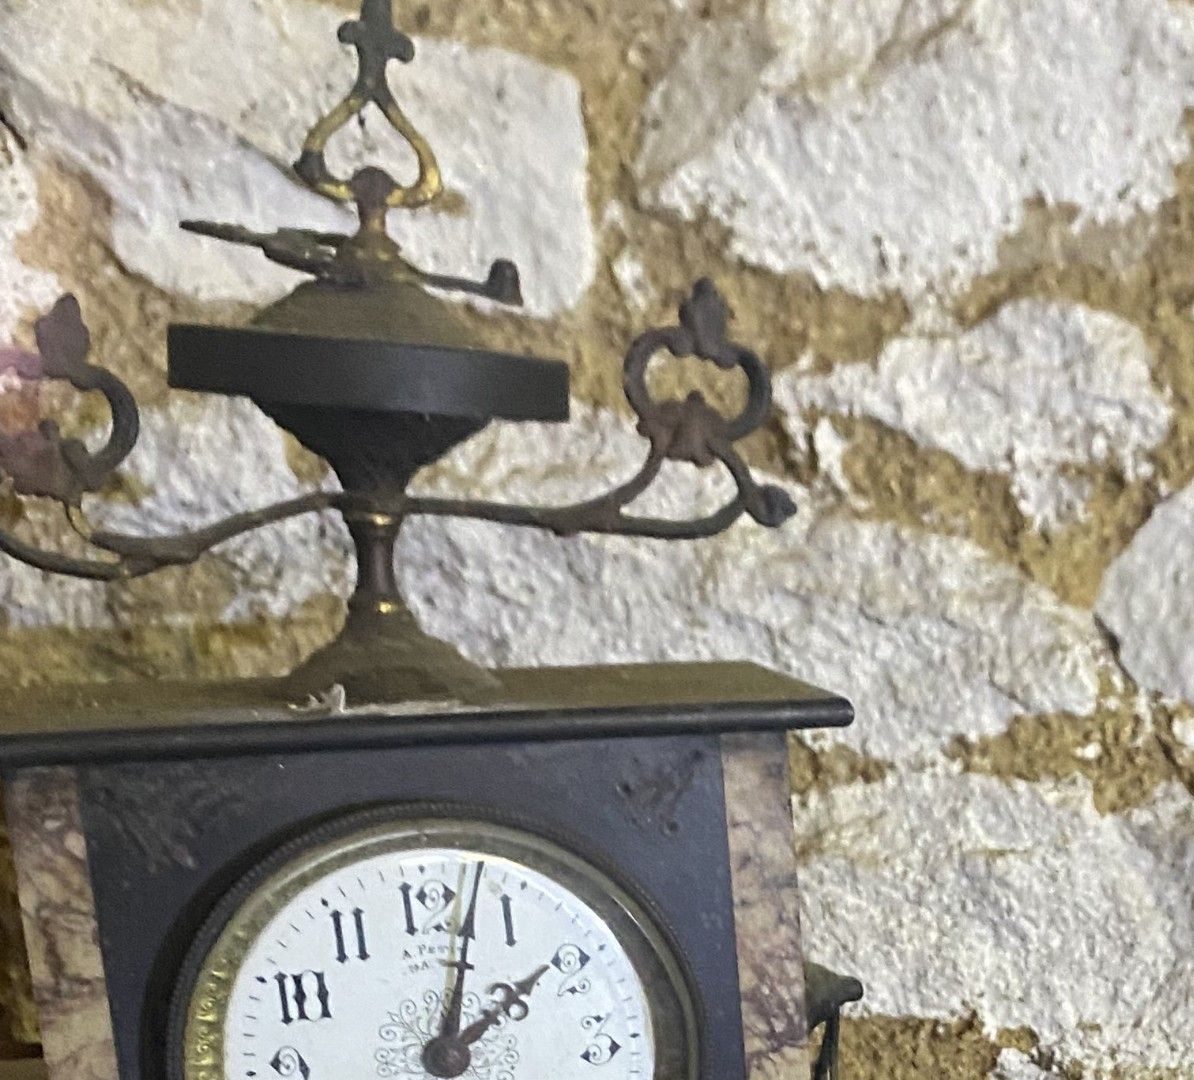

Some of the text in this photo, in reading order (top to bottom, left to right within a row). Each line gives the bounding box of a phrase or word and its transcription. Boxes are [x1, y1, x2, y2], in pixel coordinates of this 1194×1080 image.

[331, 907, 371, 964] 11
[399, 879, 456, 937] 12
[501, 893, 518, 947] 1
[274, 969, 332, 1025] 10
[550, 943, 591, 997] 2
[580, 1013, 622, 1067] 3
